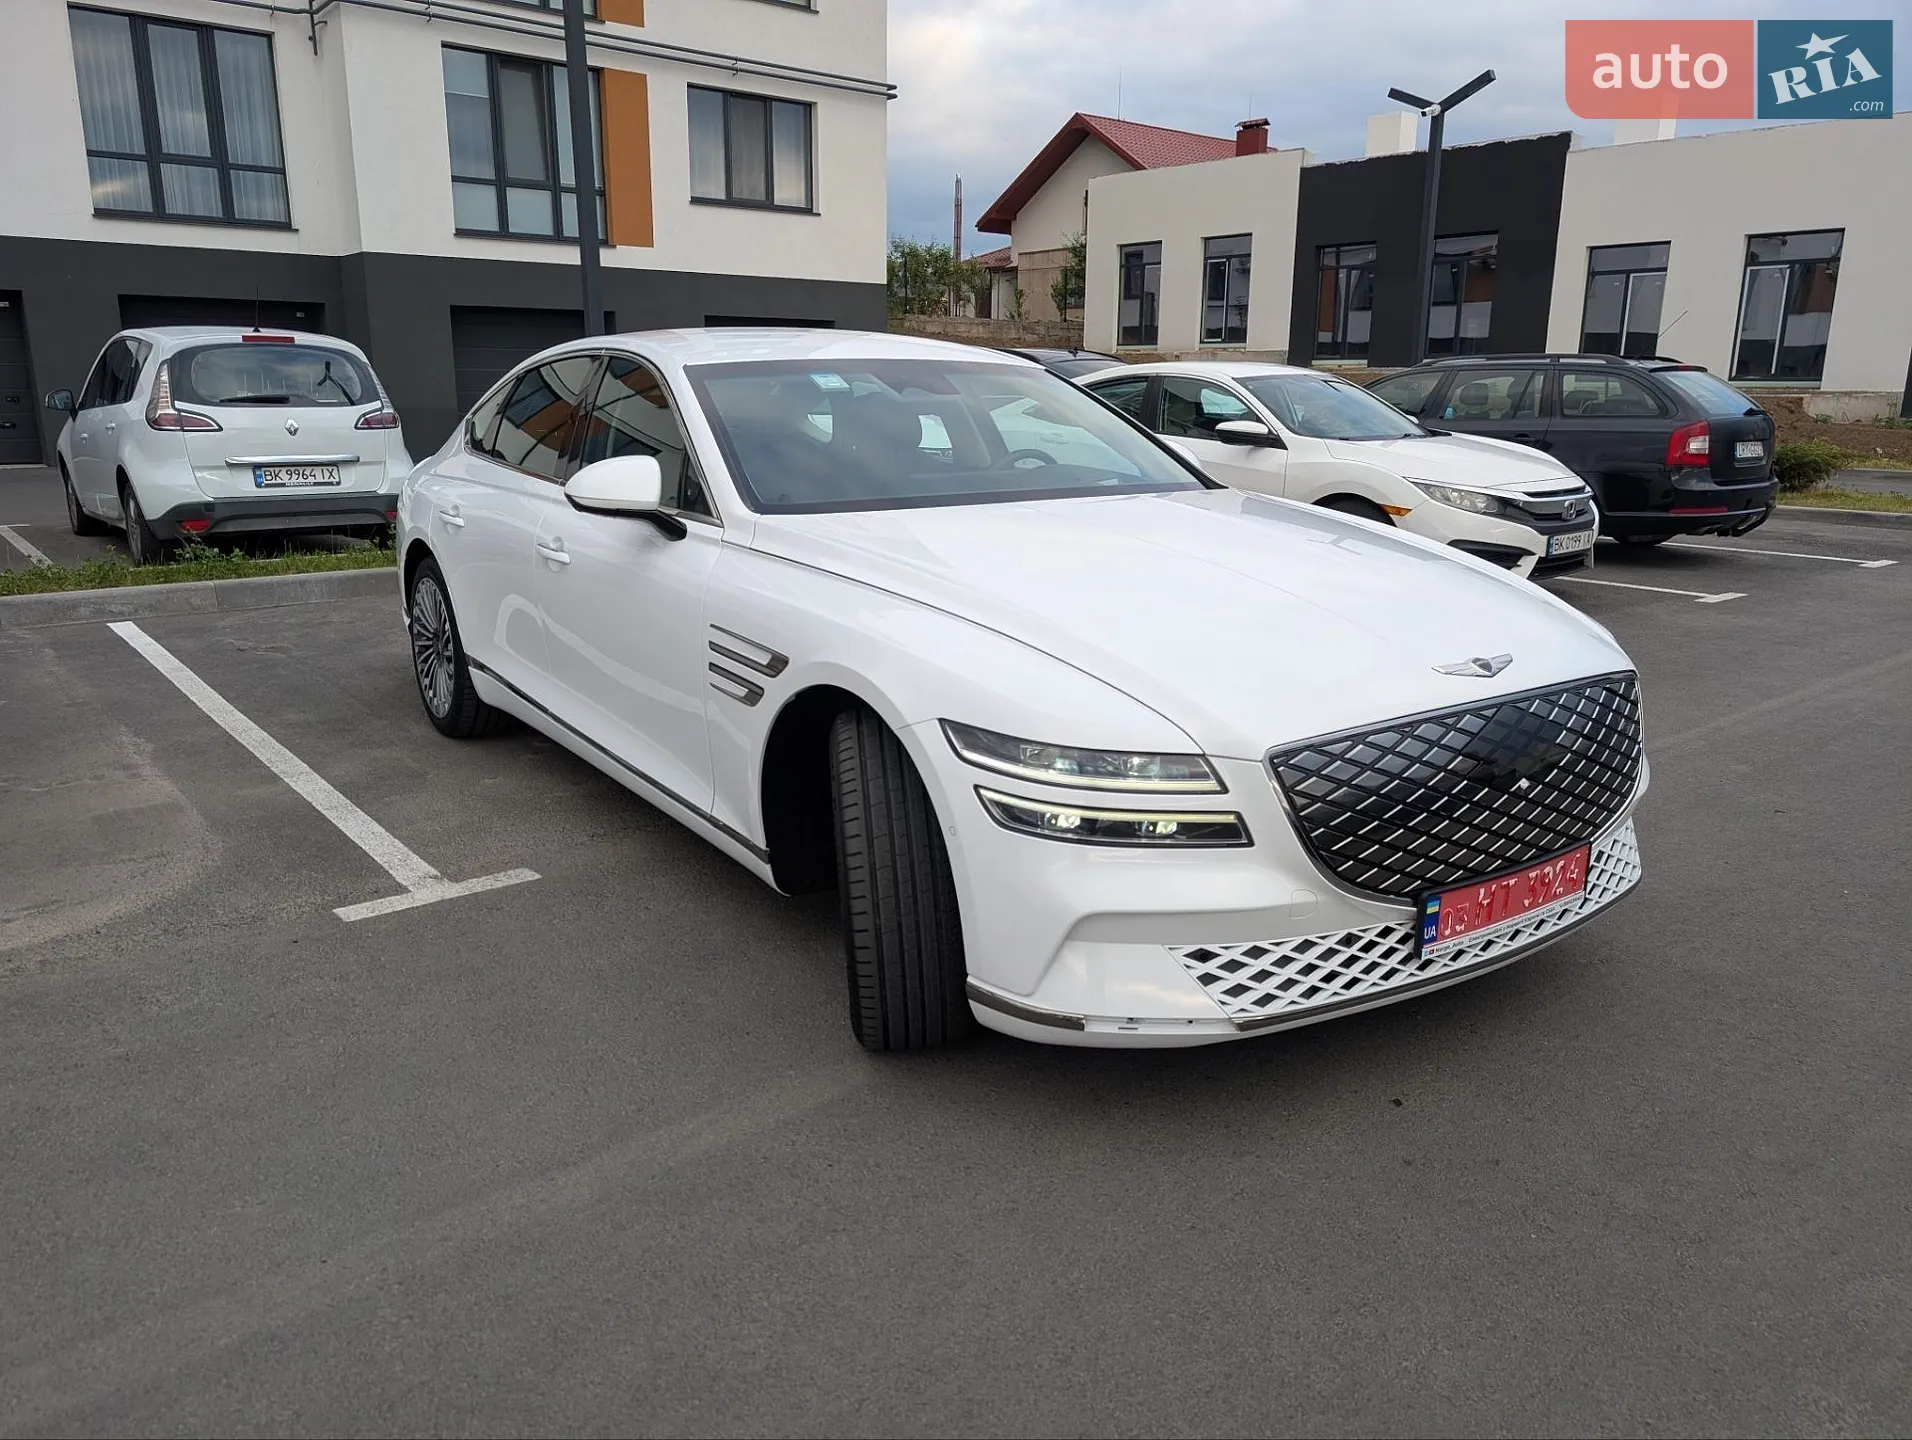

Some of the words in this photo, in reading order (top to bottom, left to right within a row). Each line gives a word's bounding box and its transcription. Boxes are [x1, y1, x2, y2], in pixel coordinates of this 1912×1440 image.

[264, 469, 283, 481] BK
[286, 468, 317, 480] 9964
[321, 468, 336, 480] IX
[1424, 926, 1436, 939] UA
